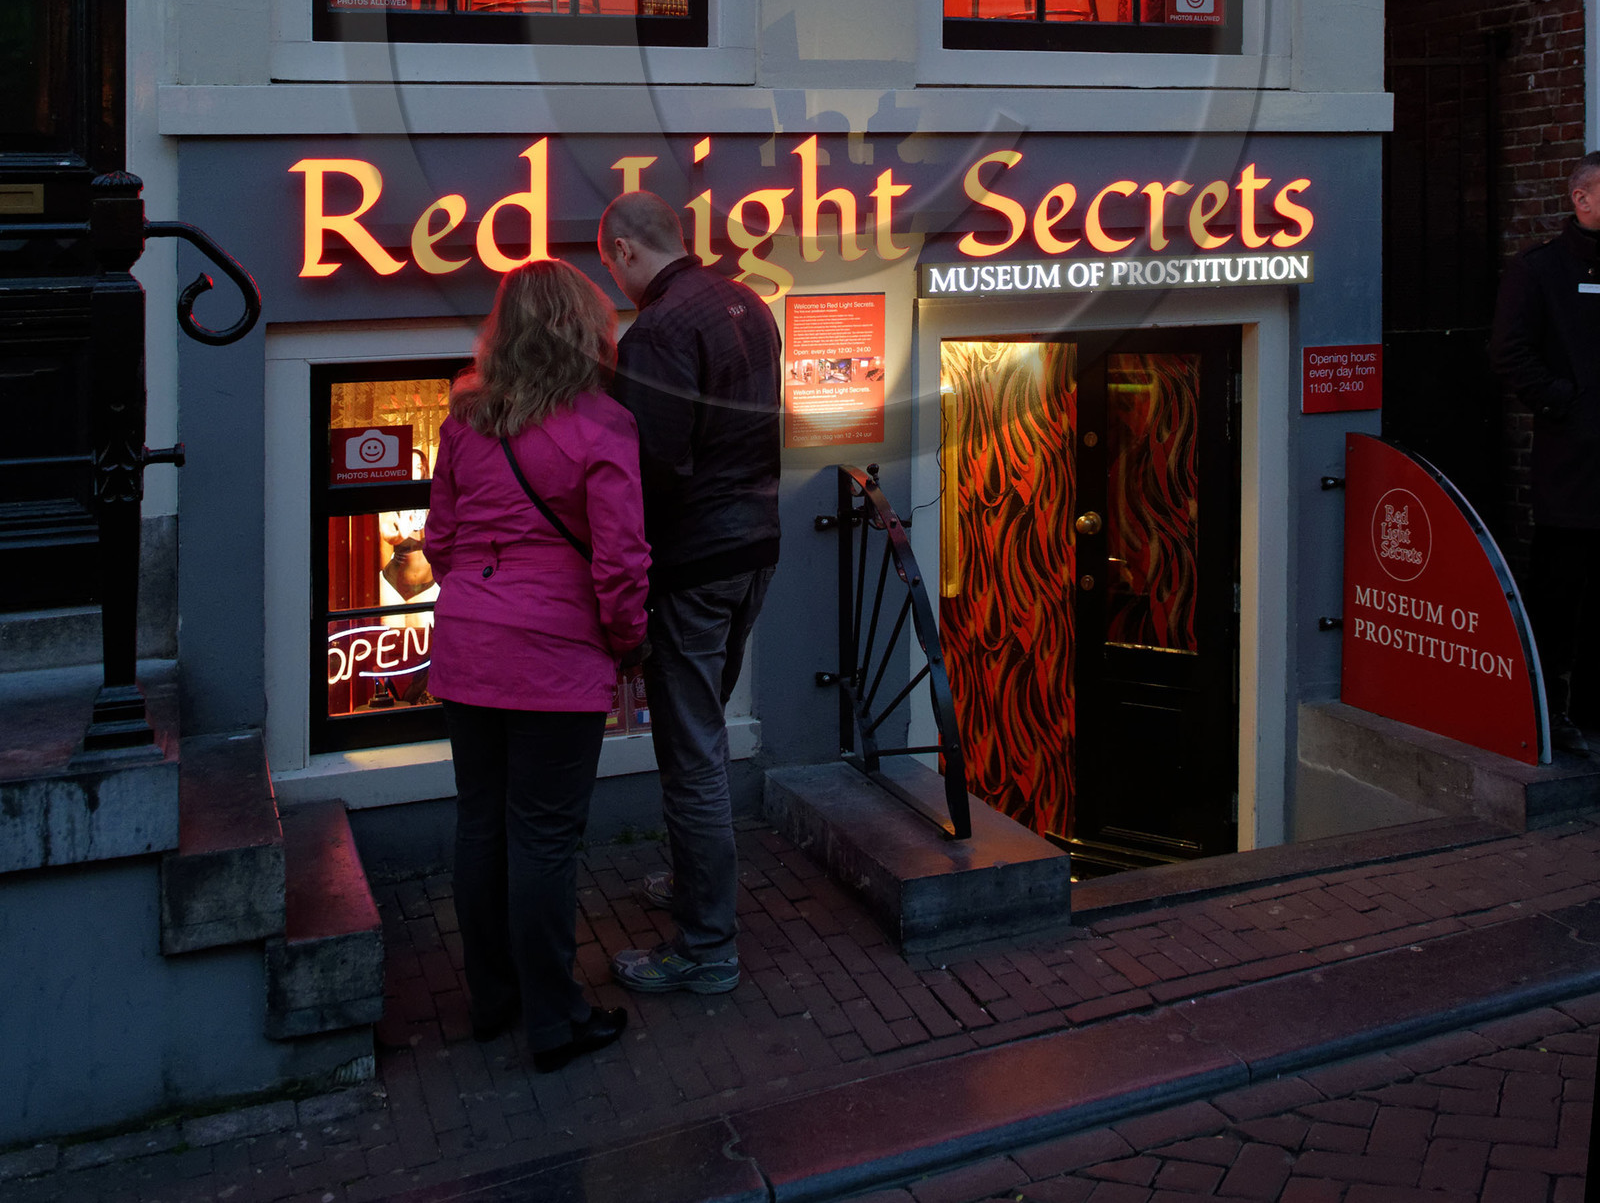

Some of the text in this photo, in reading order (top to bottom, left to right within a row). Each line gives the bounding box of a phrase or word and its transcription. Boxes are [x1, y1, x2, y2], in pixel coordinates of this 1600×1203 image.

[287, 136, 560, 278] Red
[958, 150, 1315, 257] Secrets
[929, 254, 1310, 294] MUSEUM OF PROSTITUTION
[839, 302, 852, 310] Light
[1309, 353, 1348, 366] Opening
[1309, 365, 1376, 379] every day from
[1310, 382, 1333, 394] 11:00
[1339, 380, 1364, 392] 24:00
[336, 469, 408, 480] PHOTOS ALLOWED
[1384, 504, 1409, 525] Red
[1380, 522, 1412, 548] Light
[1380, 540, 1422, 564] Secrets
[1354, 584, 1479, 634] MUSEUM OF
[328, 622, 431, 685] OPEN
[1354, 617, 1514, 681] PROSTITUTION
